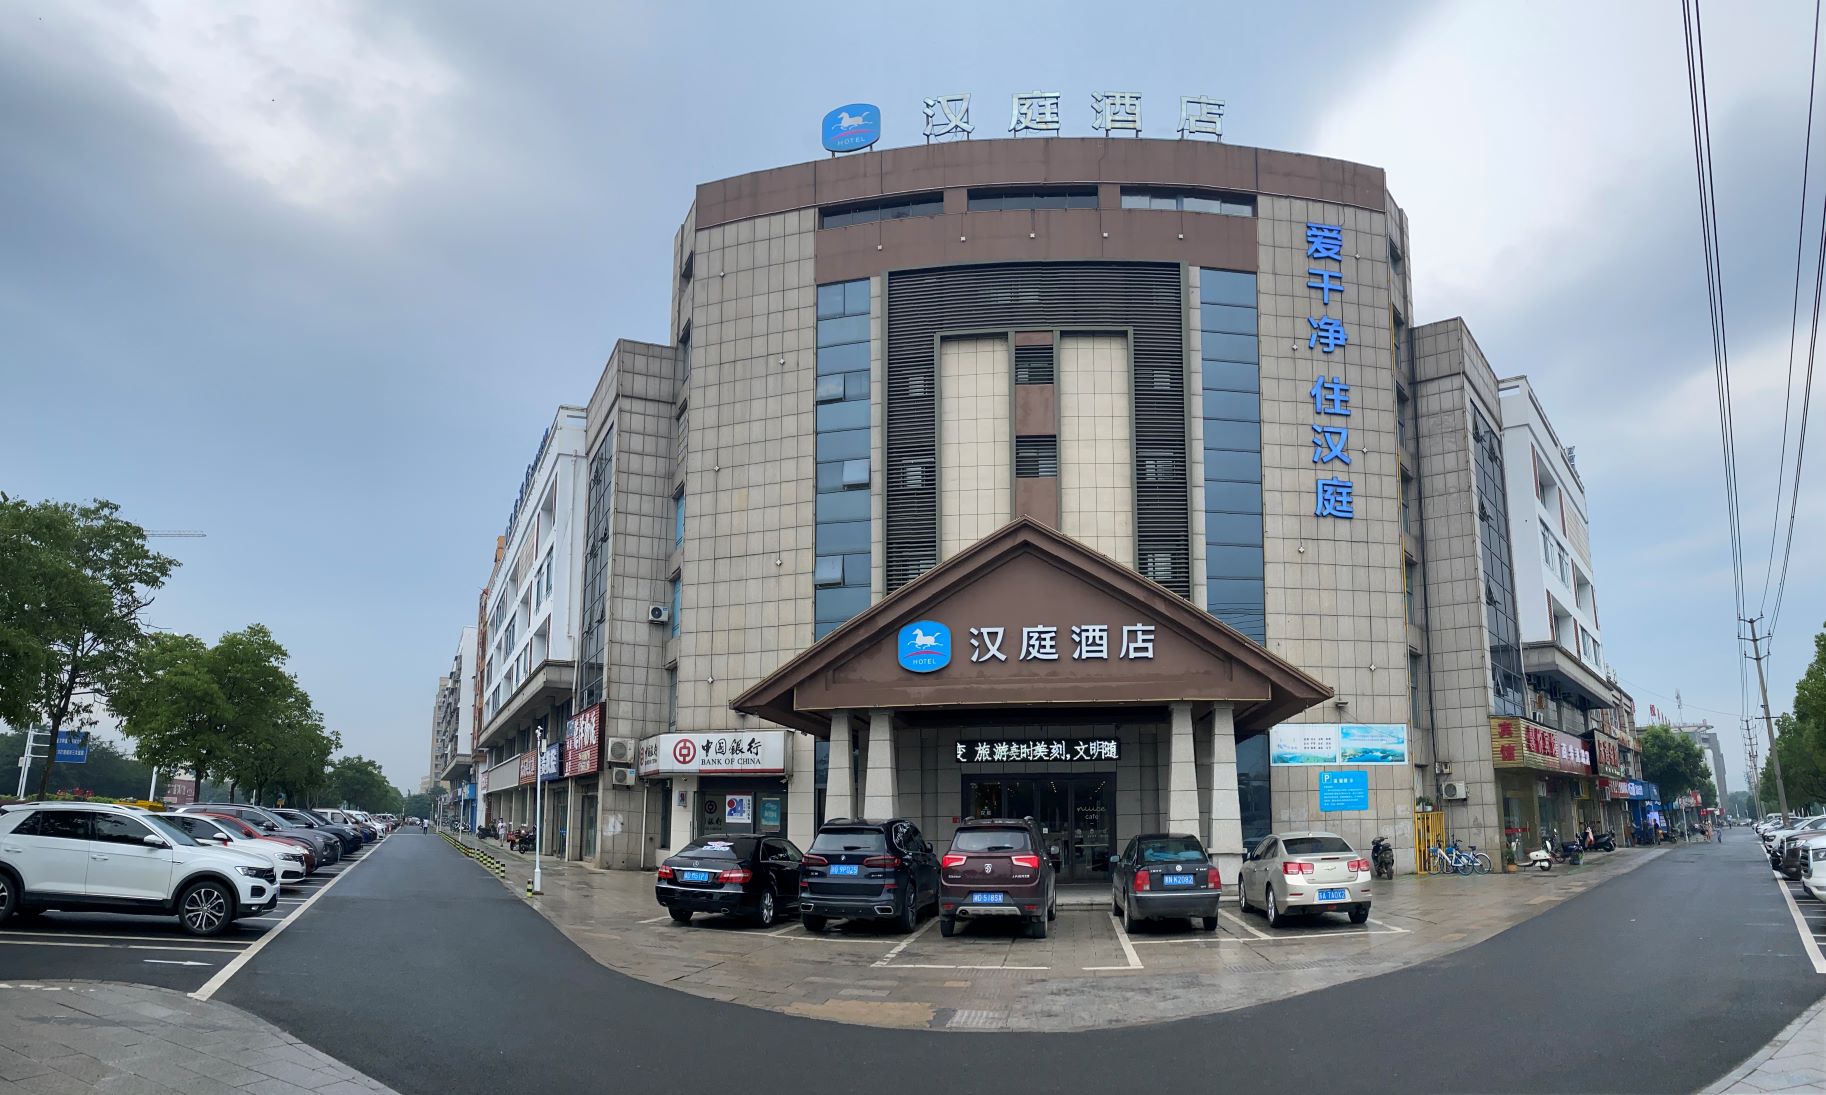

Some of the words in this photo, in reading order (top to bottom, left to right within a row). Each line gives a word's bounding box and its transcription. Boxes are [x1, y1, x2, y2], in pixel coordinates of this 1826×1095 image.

[922, 90, 1226, 136] 汉庭酒店
[836, 136, 865, 146] HOTEL
[1305, 222, 1348, 354] 爱干净
[1309, 375, 1355, 520] 住汉庭
[912, 657, 937, 666] HOTEL
[969, 623, 1156, 663] 汉庭酒店
[701, 758, 722, 766] BANK
[737, 757, 762, 765] CHINA
